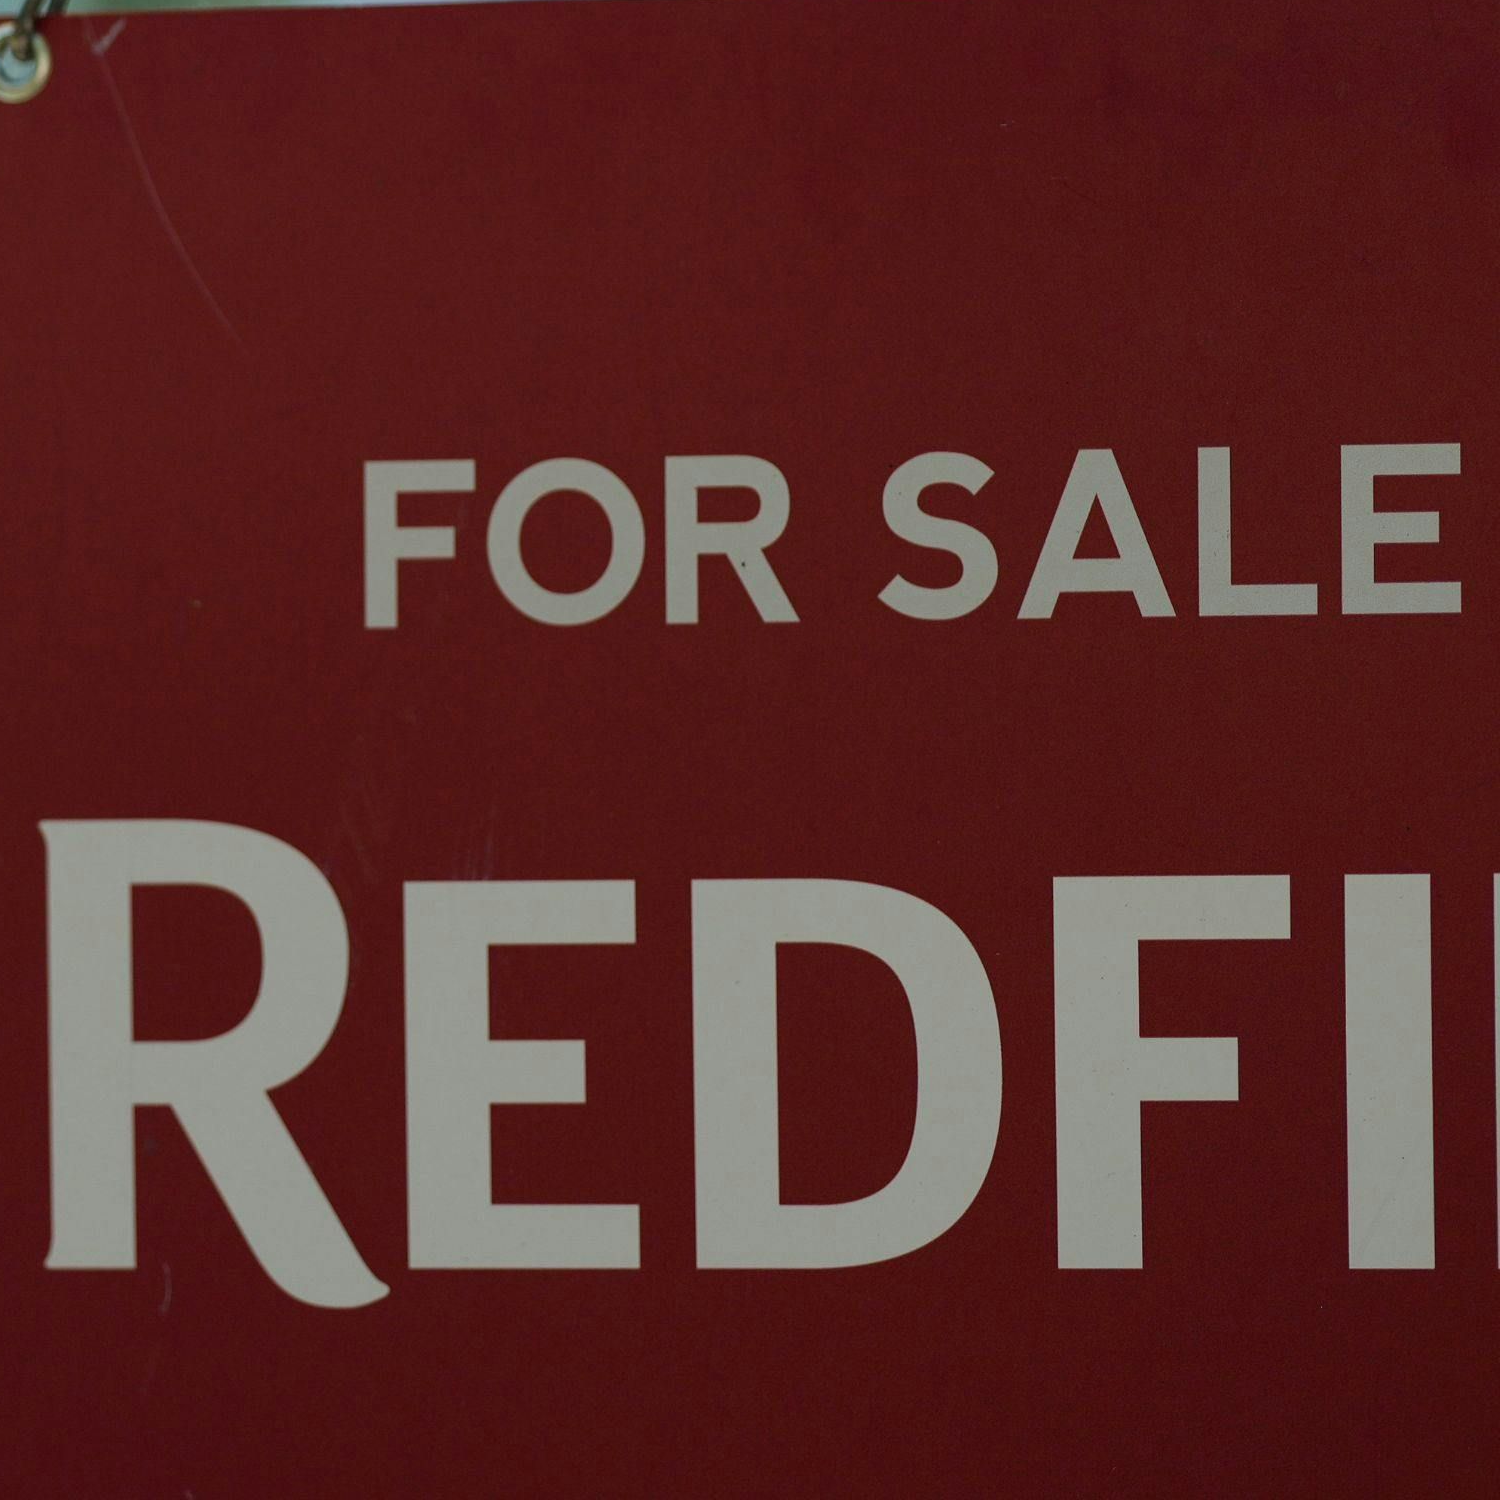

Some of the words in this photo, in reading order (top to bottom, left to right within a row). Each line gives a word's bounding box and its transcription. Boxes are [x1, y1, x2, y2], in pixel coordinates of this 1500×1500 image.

[364, 454, 800, 629] FOR
[877, 442, 1462, 621] SALE
[39, 818, 1500, 1309] REDFI
